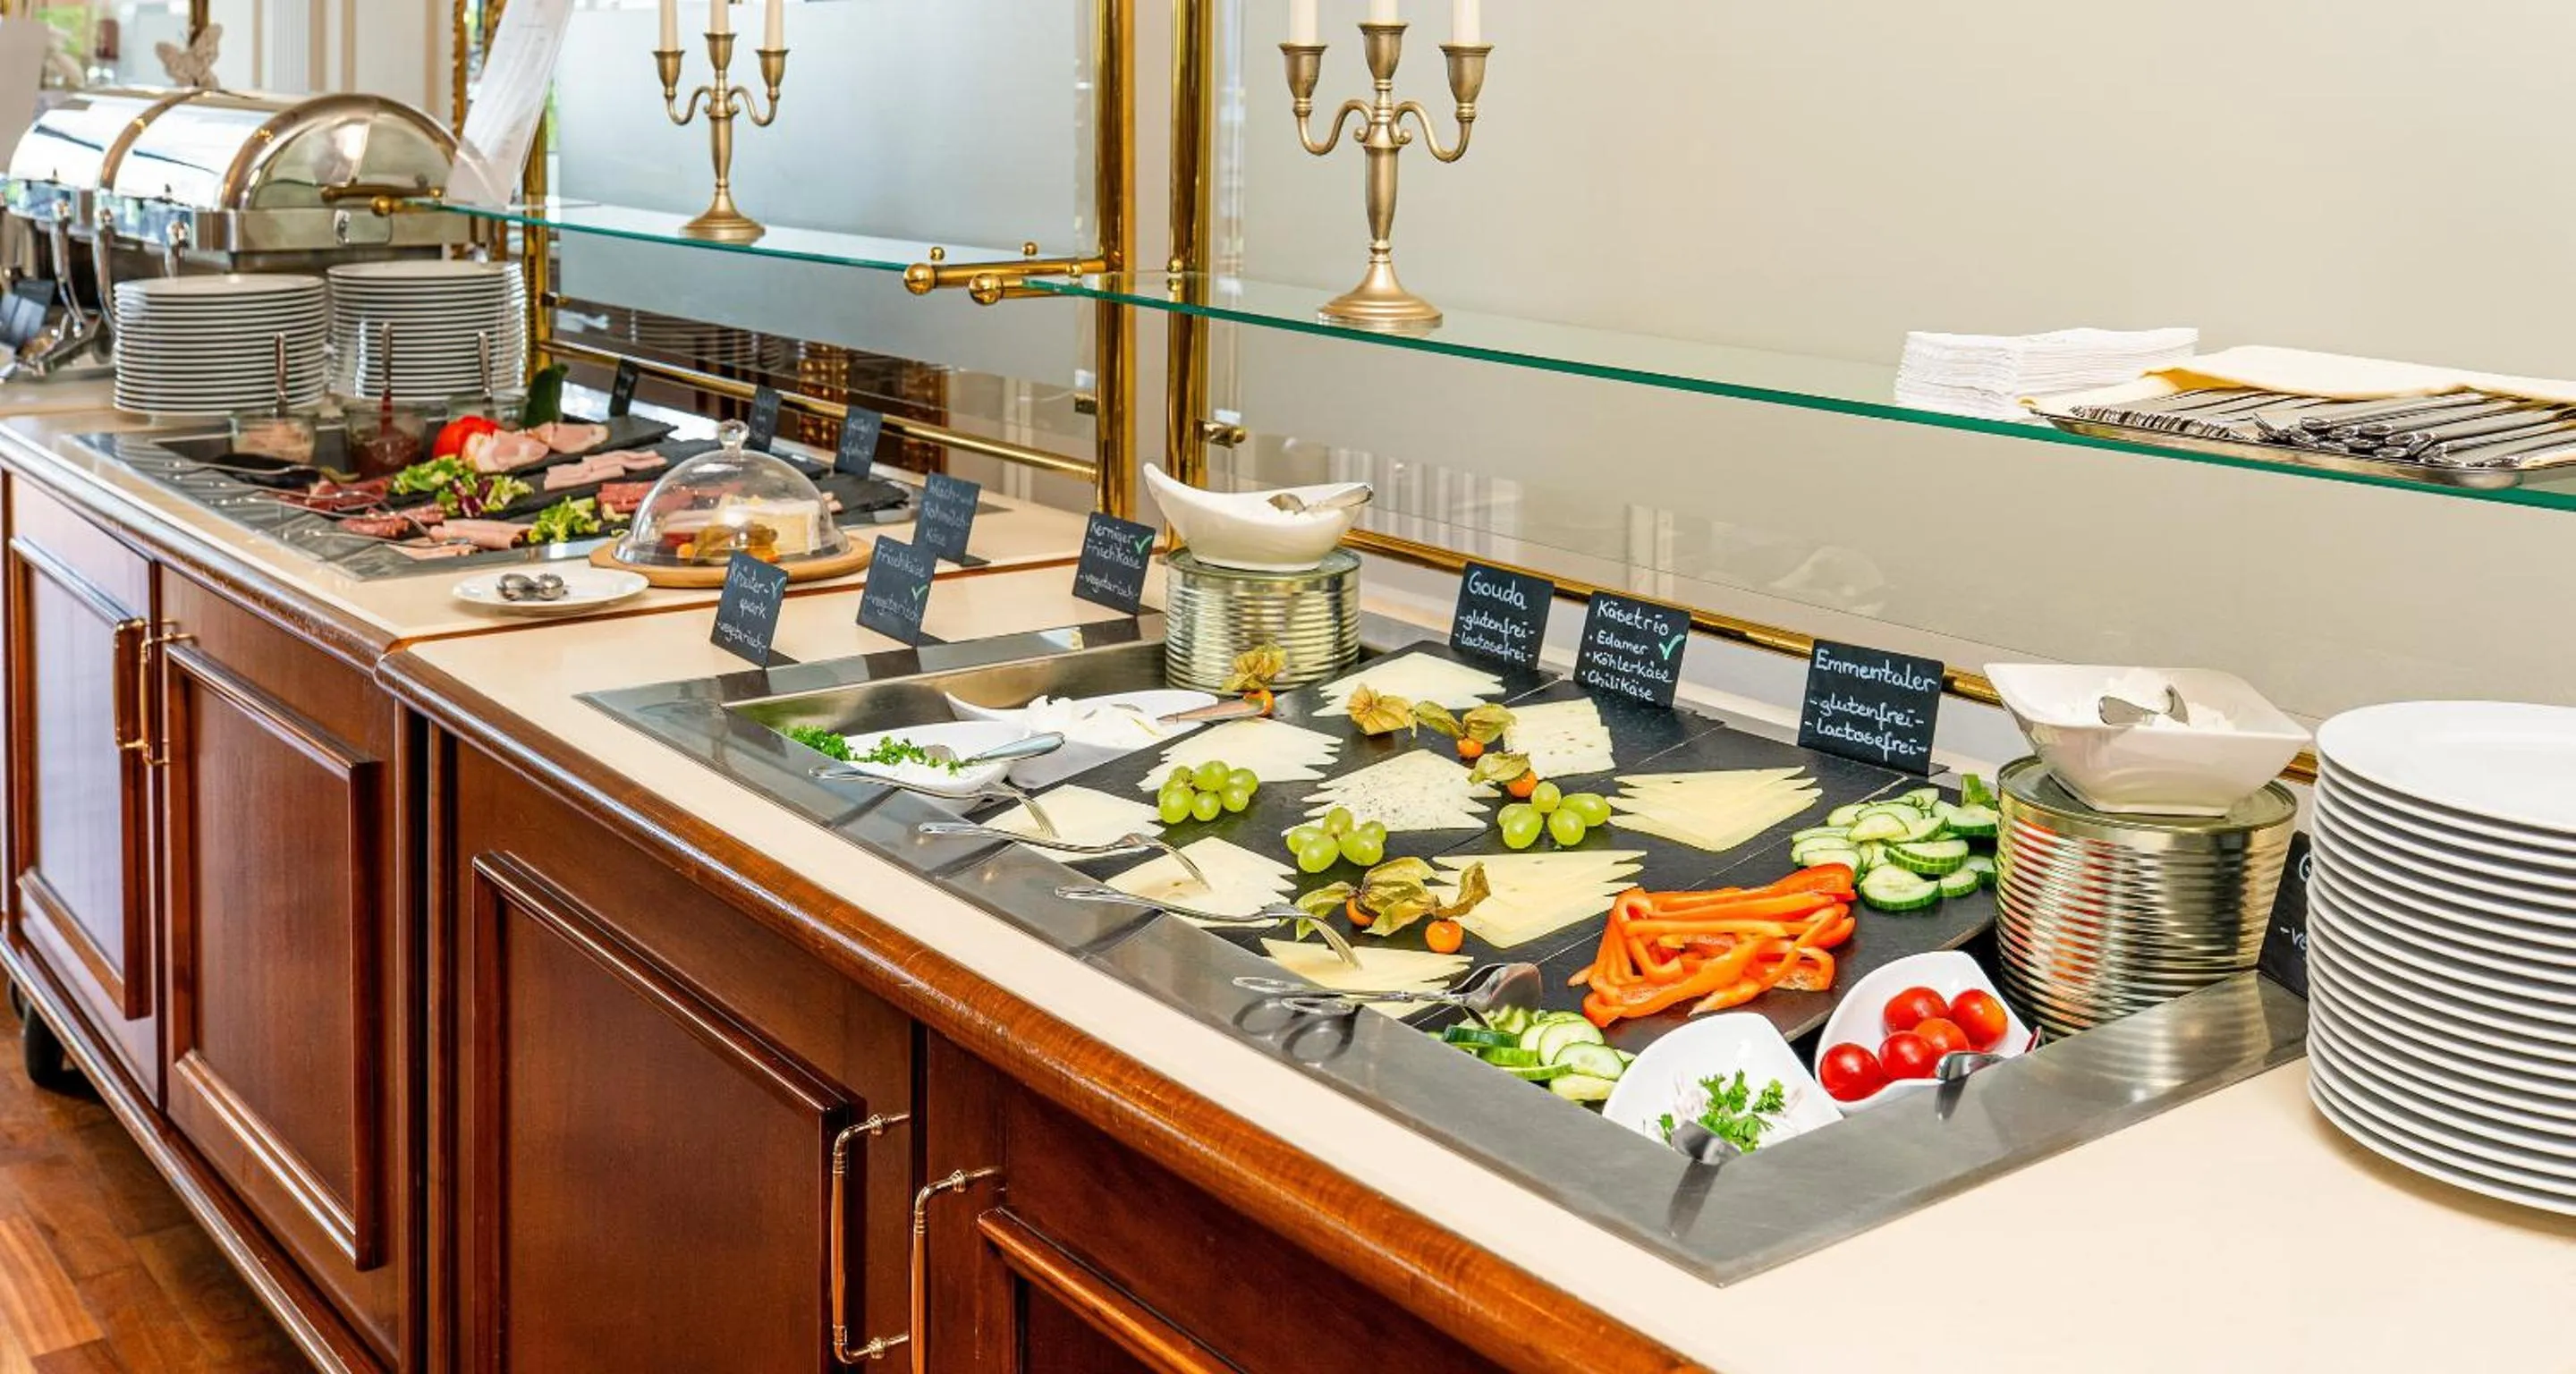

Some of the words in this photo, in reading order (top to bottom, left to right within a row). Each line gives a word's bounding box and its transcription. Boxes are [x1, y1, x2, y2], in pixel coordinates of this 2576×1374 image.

[1468, 571, 1528, 610] Gouda
[1596, 600, 1669, 636] Käsetrio
[1597, 630, 1648, 655] Edamer
[1814, 648, 1938, 692] Emmentaler
